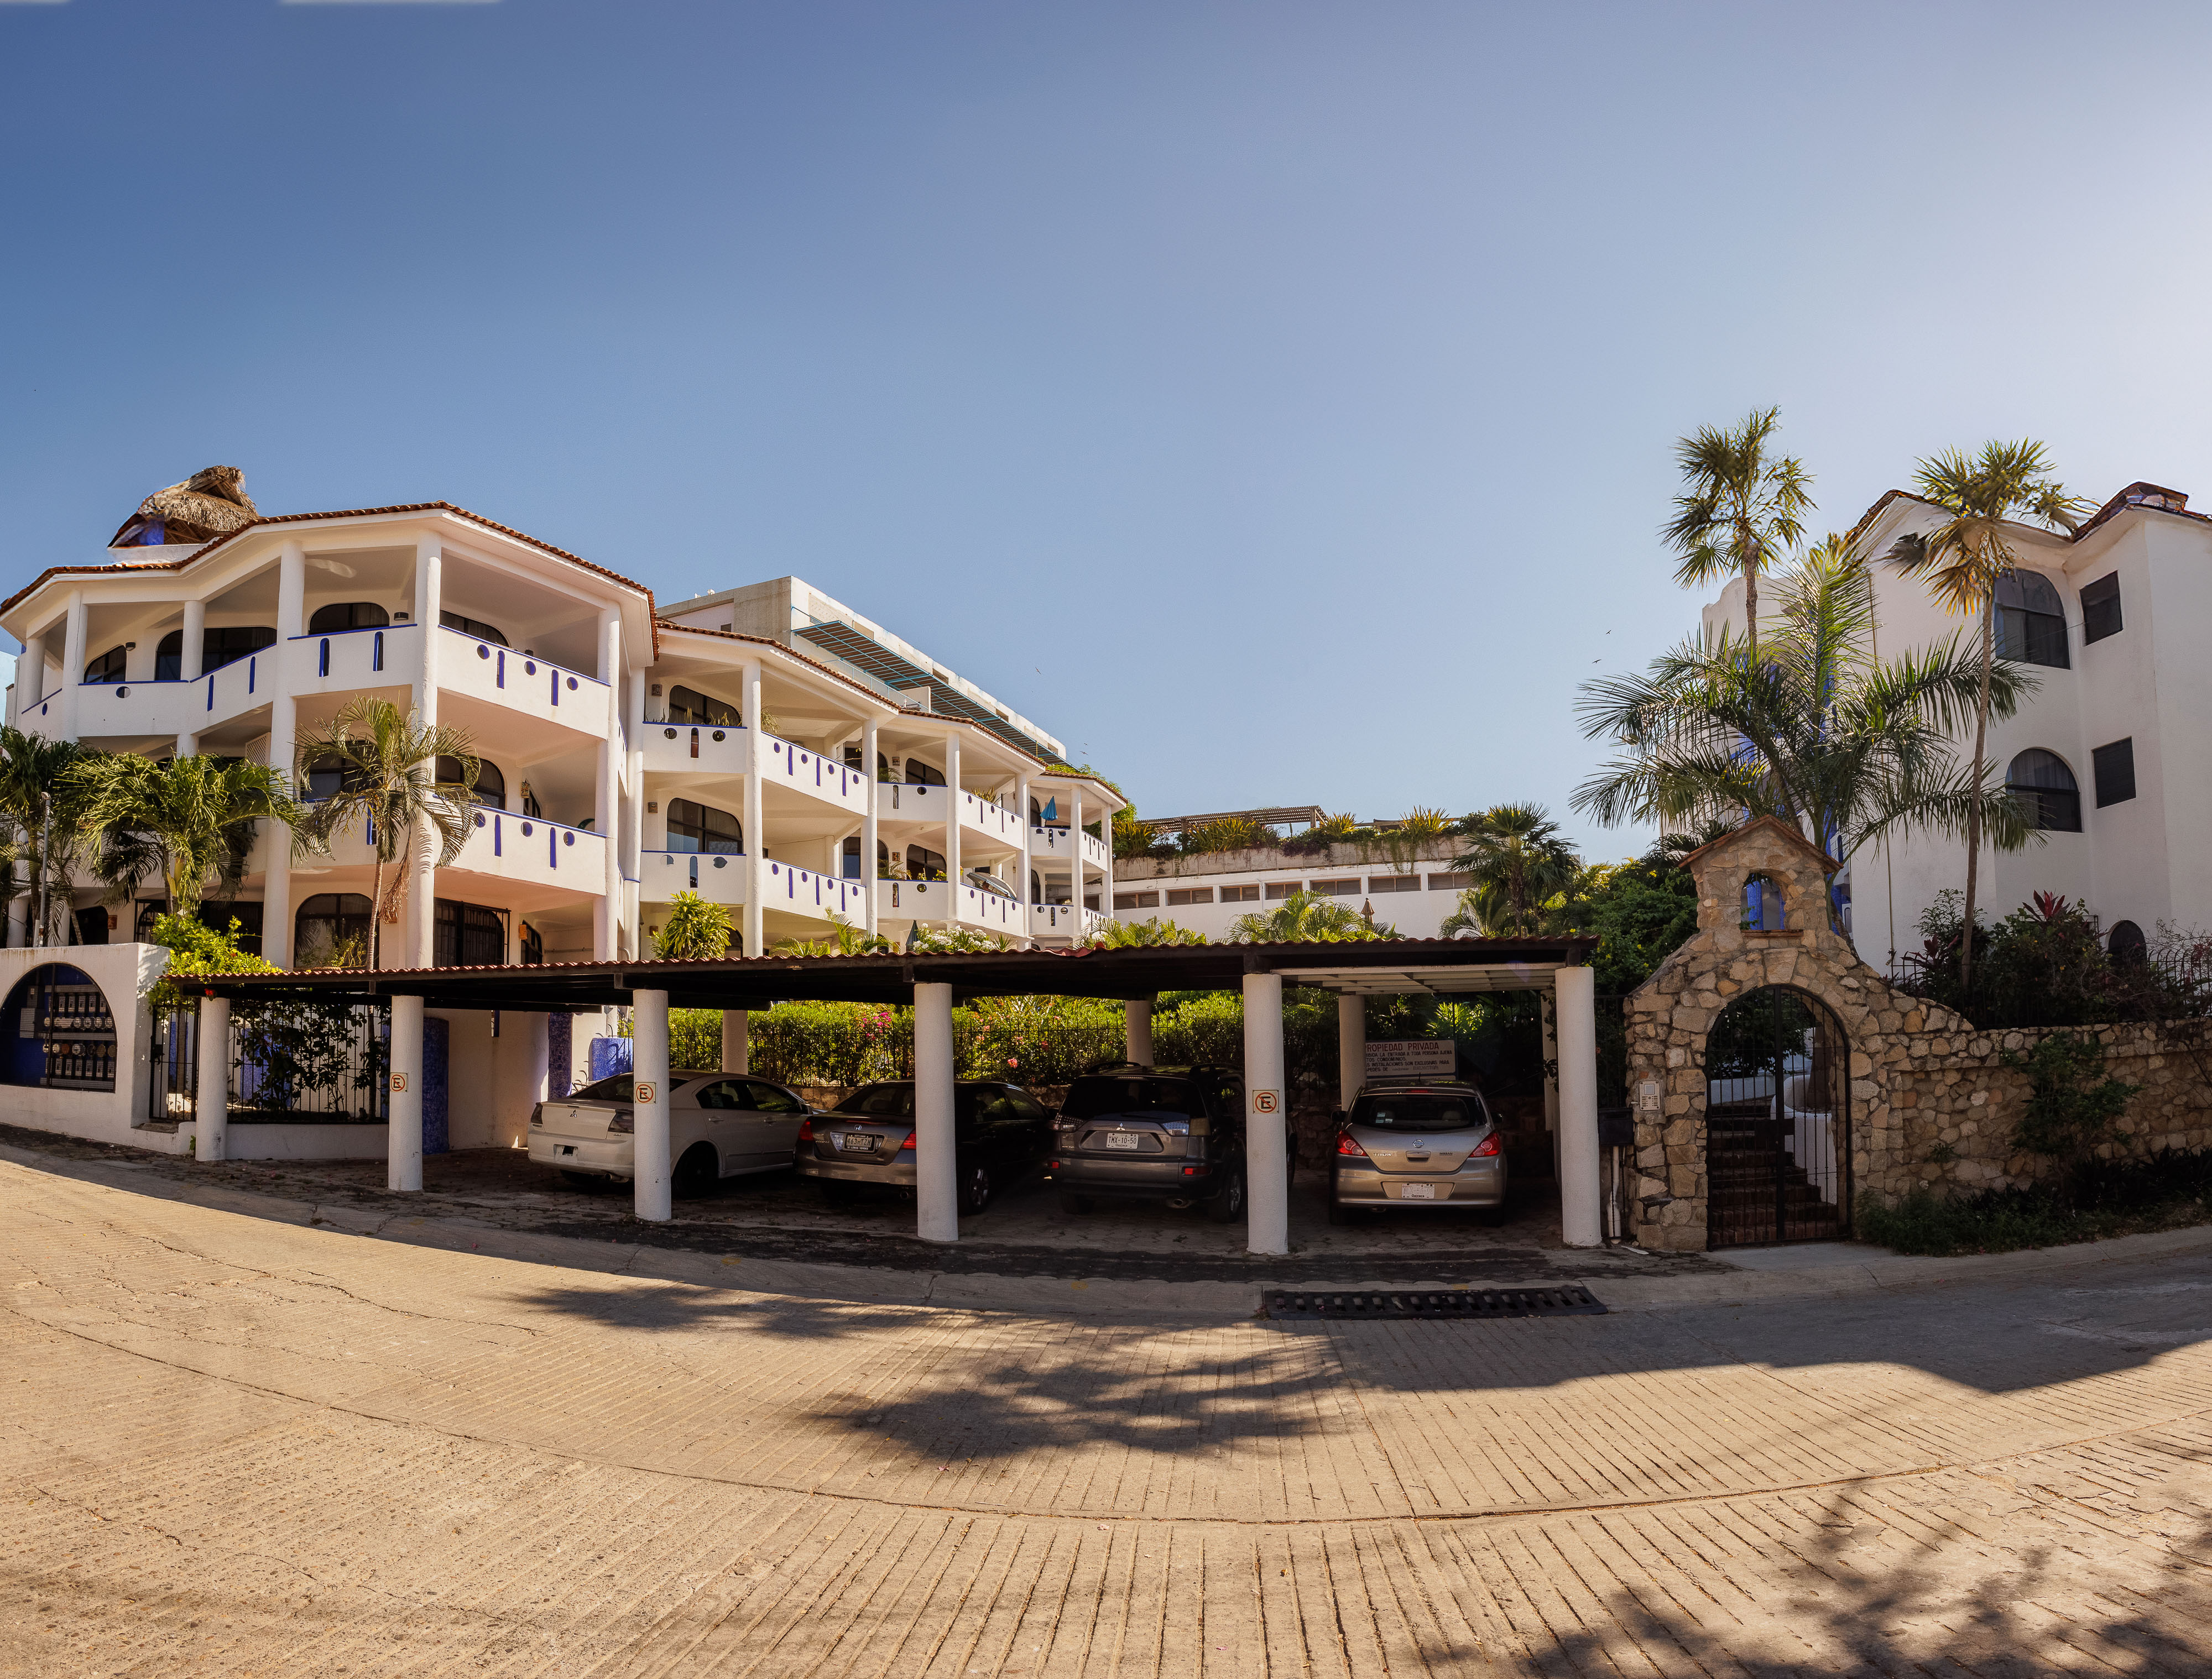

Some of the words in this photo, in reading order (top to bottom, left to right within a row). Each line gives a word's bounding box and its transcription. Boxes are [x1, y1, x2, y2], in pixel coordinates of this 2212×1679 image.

[1365, 1043, 1402, 1052] ROPIEDAD
[1408, 1042, 1439, 1050] PRIVADA
[394, 1078, 400, 1088] E
[640, 1087, 648, 1099] E
[1261, 1096, 1271, 1109] E
[847, 1138, 871, 1146] 463-TZH
